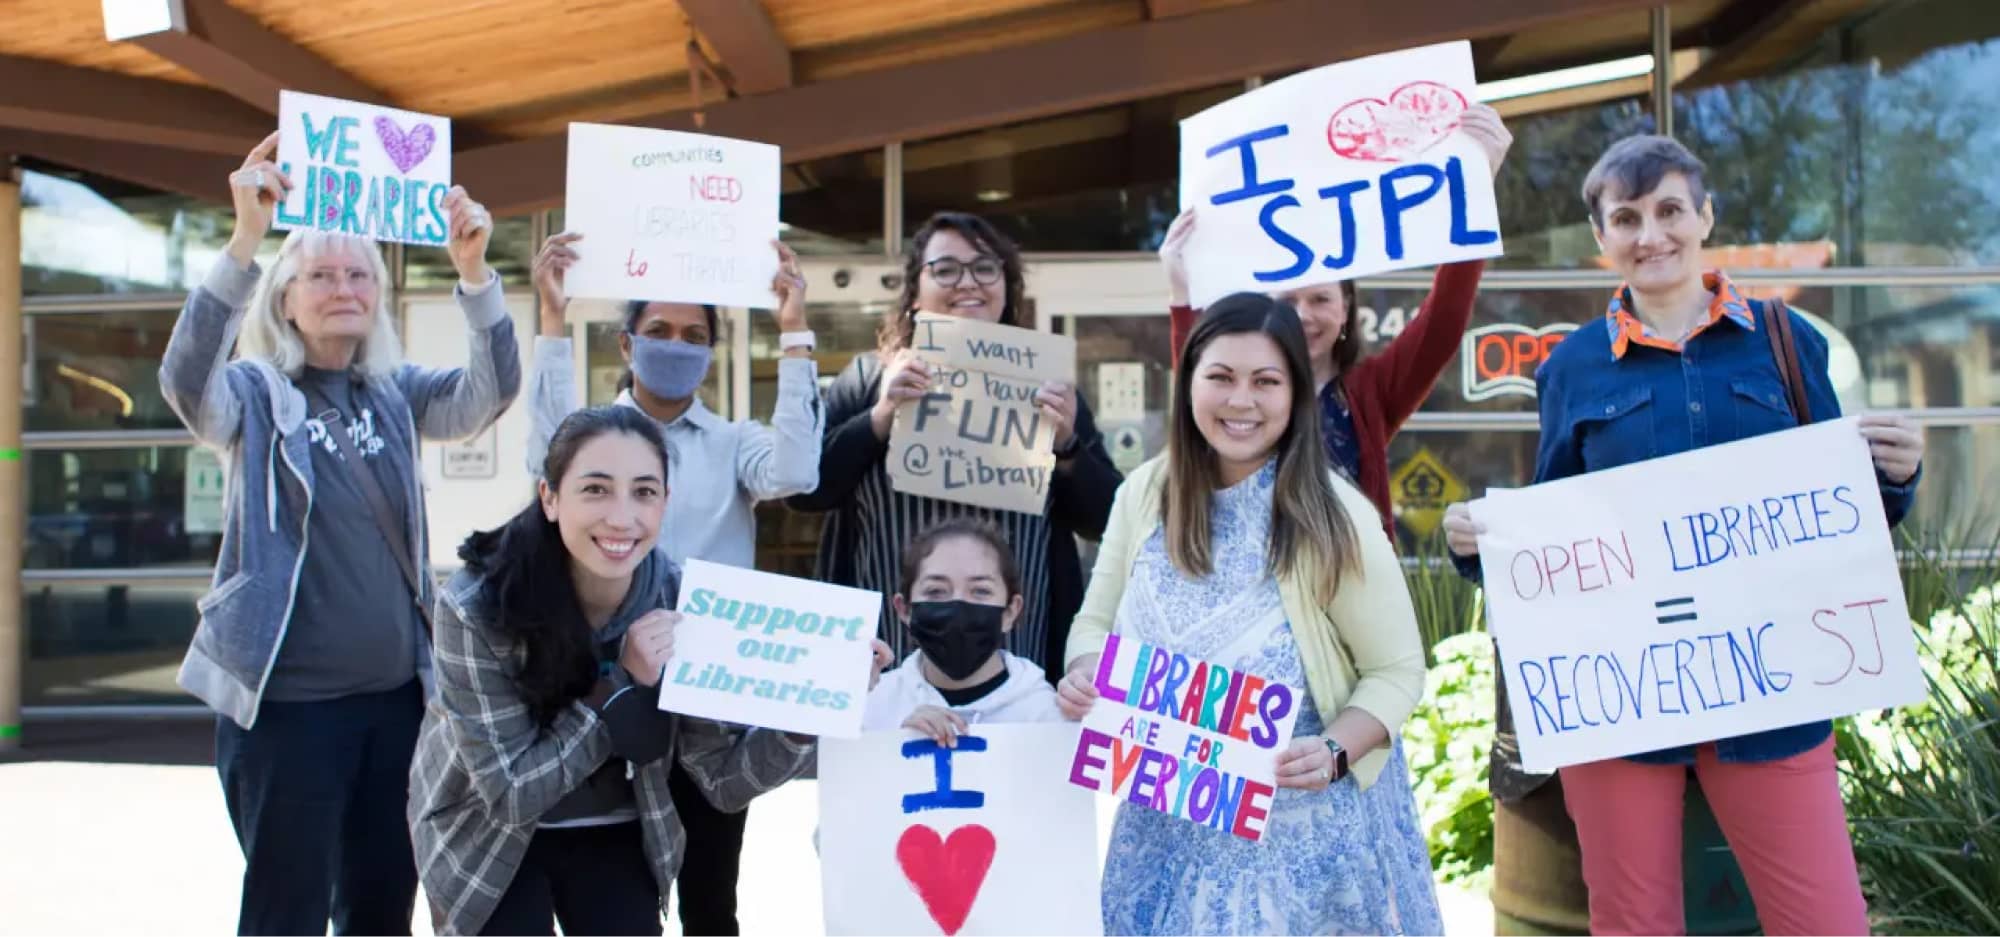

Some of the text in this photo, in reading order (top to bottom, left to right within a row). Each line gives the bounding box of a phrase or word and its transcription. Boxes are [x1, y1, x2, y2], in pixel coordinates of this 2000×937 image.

[302, 112, 360, 168] WE
[632, 147, 724, 168] COMMUNITIES
[1205, 124, 1295, 205] I
[278, 162, 449, 243] LIBRARIES
[689, 175, 743, 203] NEED
[633, 204, 737, 243] LIBRARIES
[1253, 156, 1498, 283] SJPL
[624, 248, 649, 277] to
[917, 320, 1039, 369] I want
[1357, 306, 1421, 342] 24
[933, 367, 968, 388] to
[914, 392, 1041, 451] FUN
[903, 443, 1047, 495] @ the Library
[1510, 486, 1860, 600] OPEN LIBRARIES
[683, 587, 865, 641] Support
[1655, 597, 1698, 625] =
[737, 638, 808, 664] our
[1519, 598, 1889, 736] RECOVERING SJ
[673, 661, 852, 711] Libraries
[1095, 634, 1293, 749] LIBRARIES
[1120, 716, 1224, 768] ARE FOR
[902, 735, 987, 813] I
[1069, 727, 1275, 842] EVERYONE
